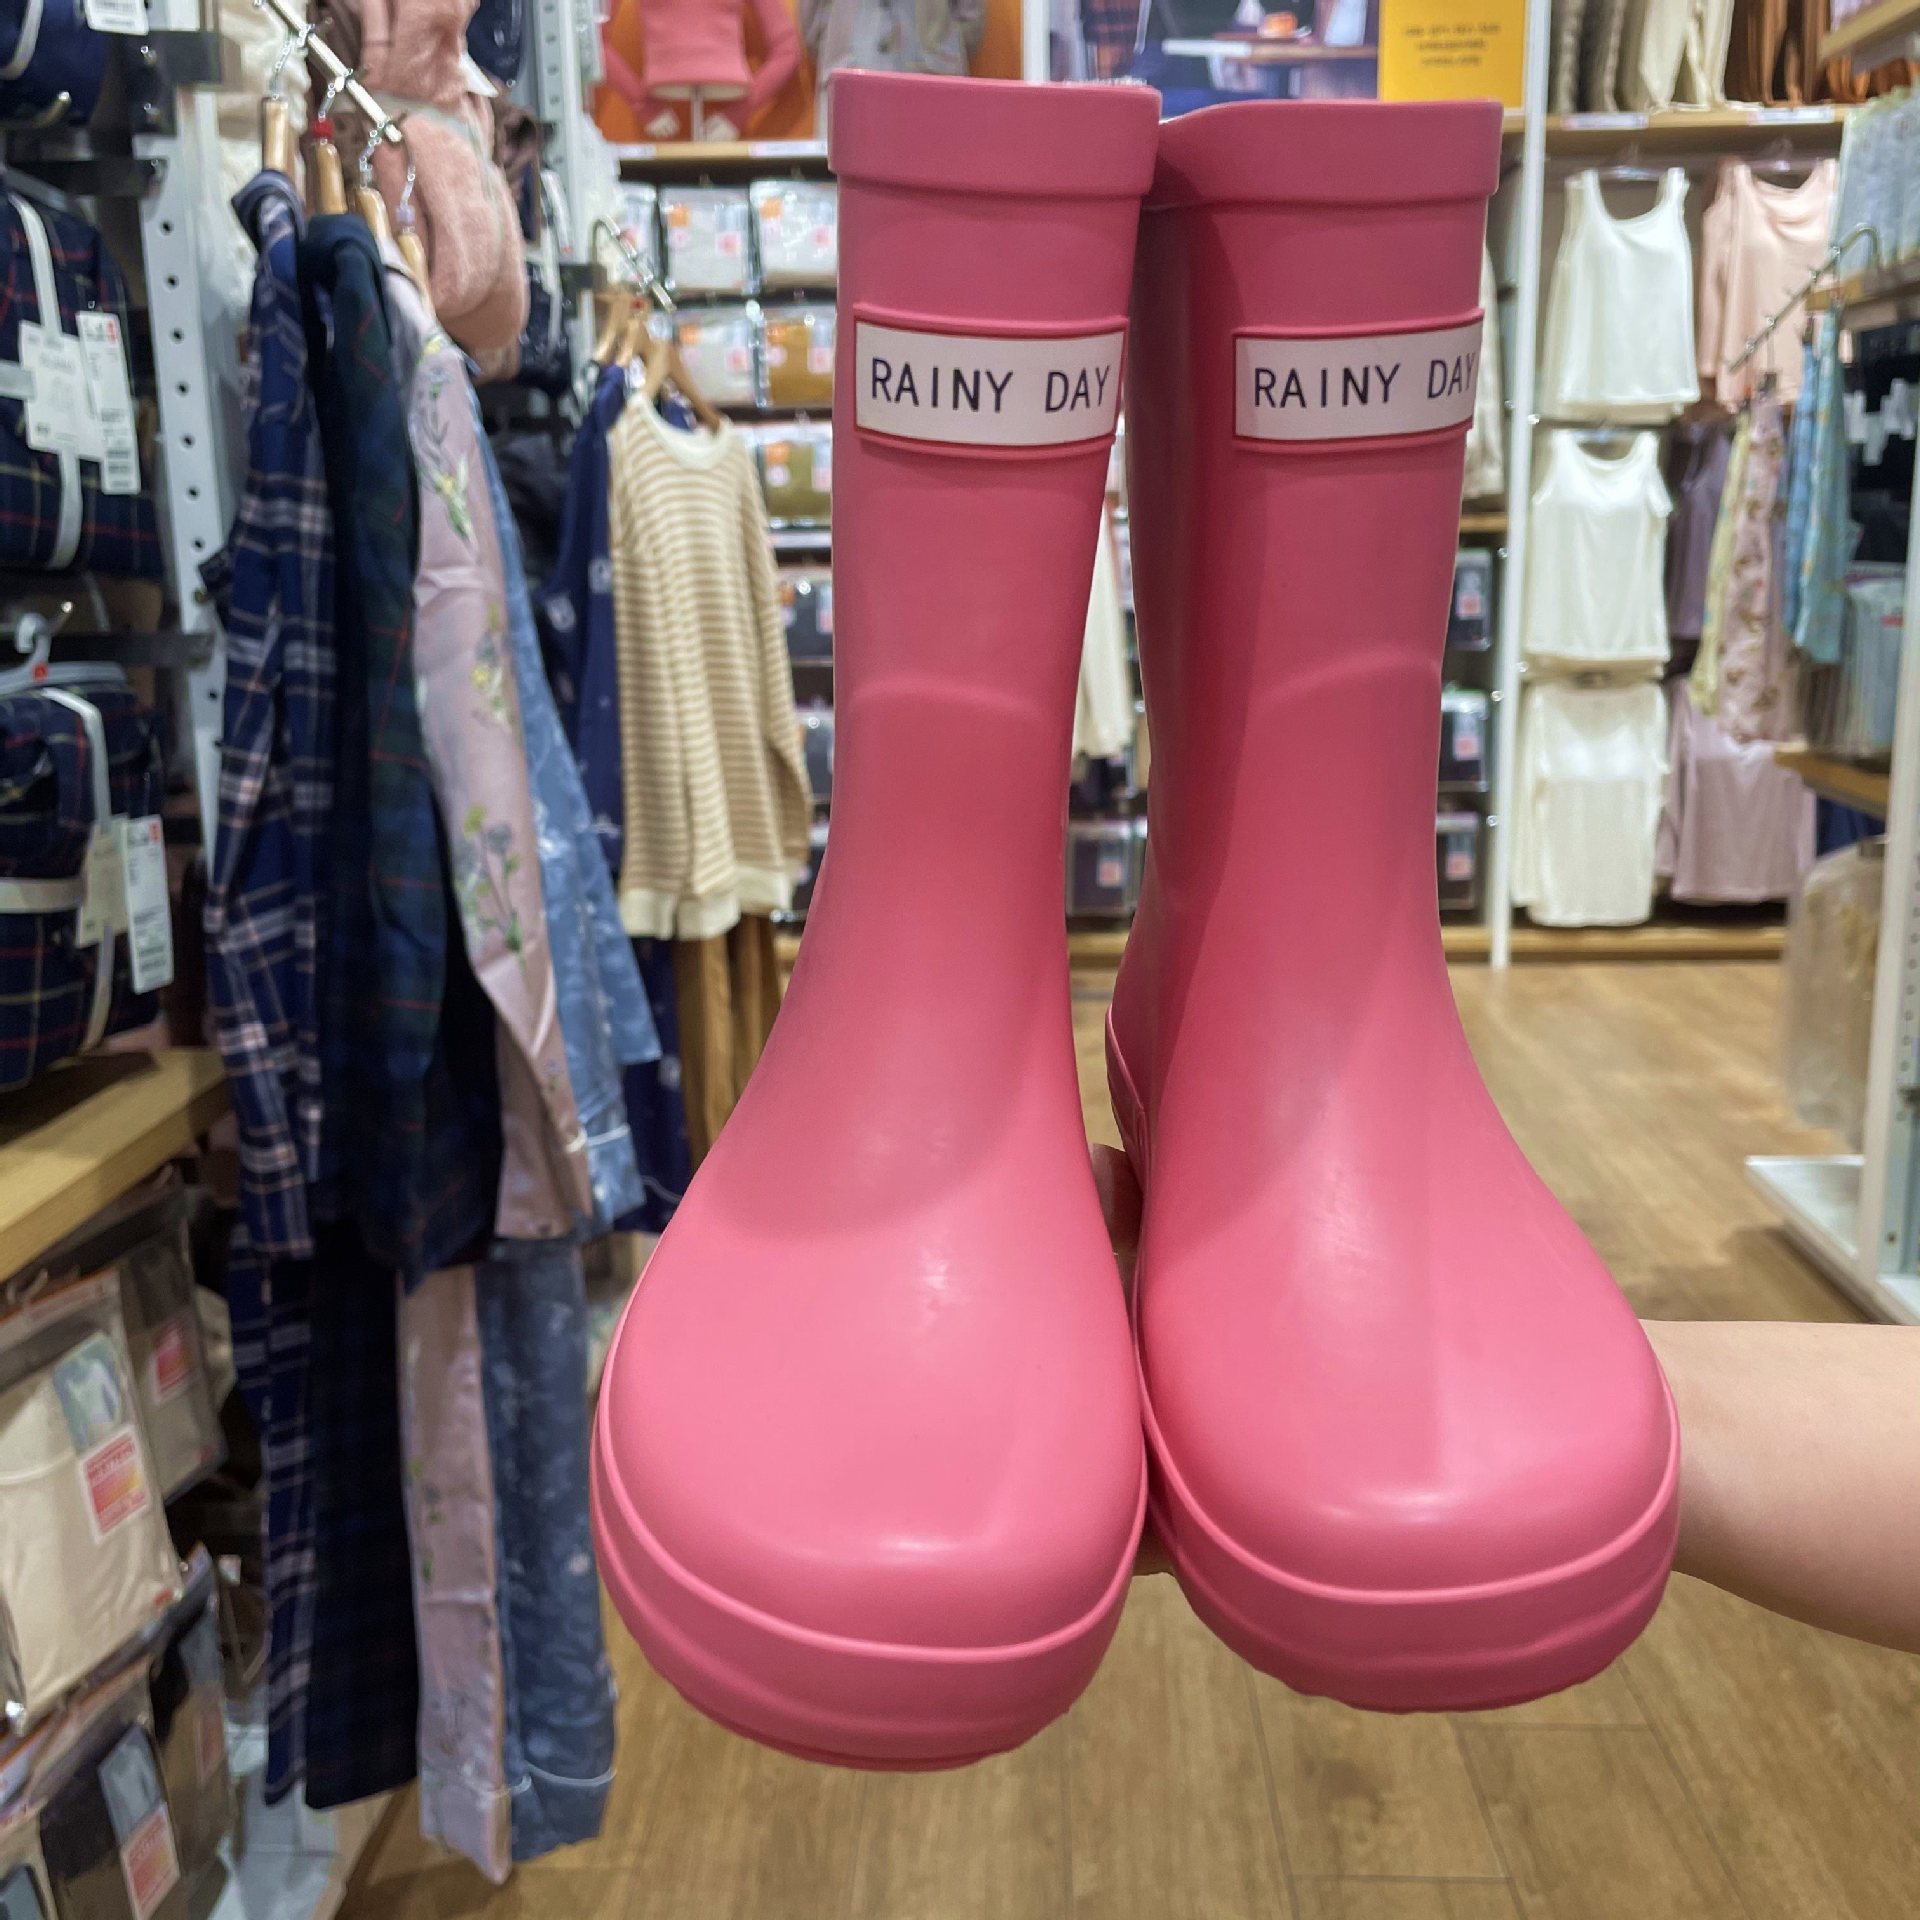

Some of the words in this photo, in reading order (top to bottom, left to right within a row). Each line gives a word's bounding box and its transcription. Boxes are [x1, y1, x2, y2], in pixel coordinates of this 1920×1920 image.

[871, 356, 1014, 414] RAINY
[1044, 364, 1111, 414] DAY
[1253, 362, 1402, 409] RAINY
[1426, 351, 1477, 400] DAY
